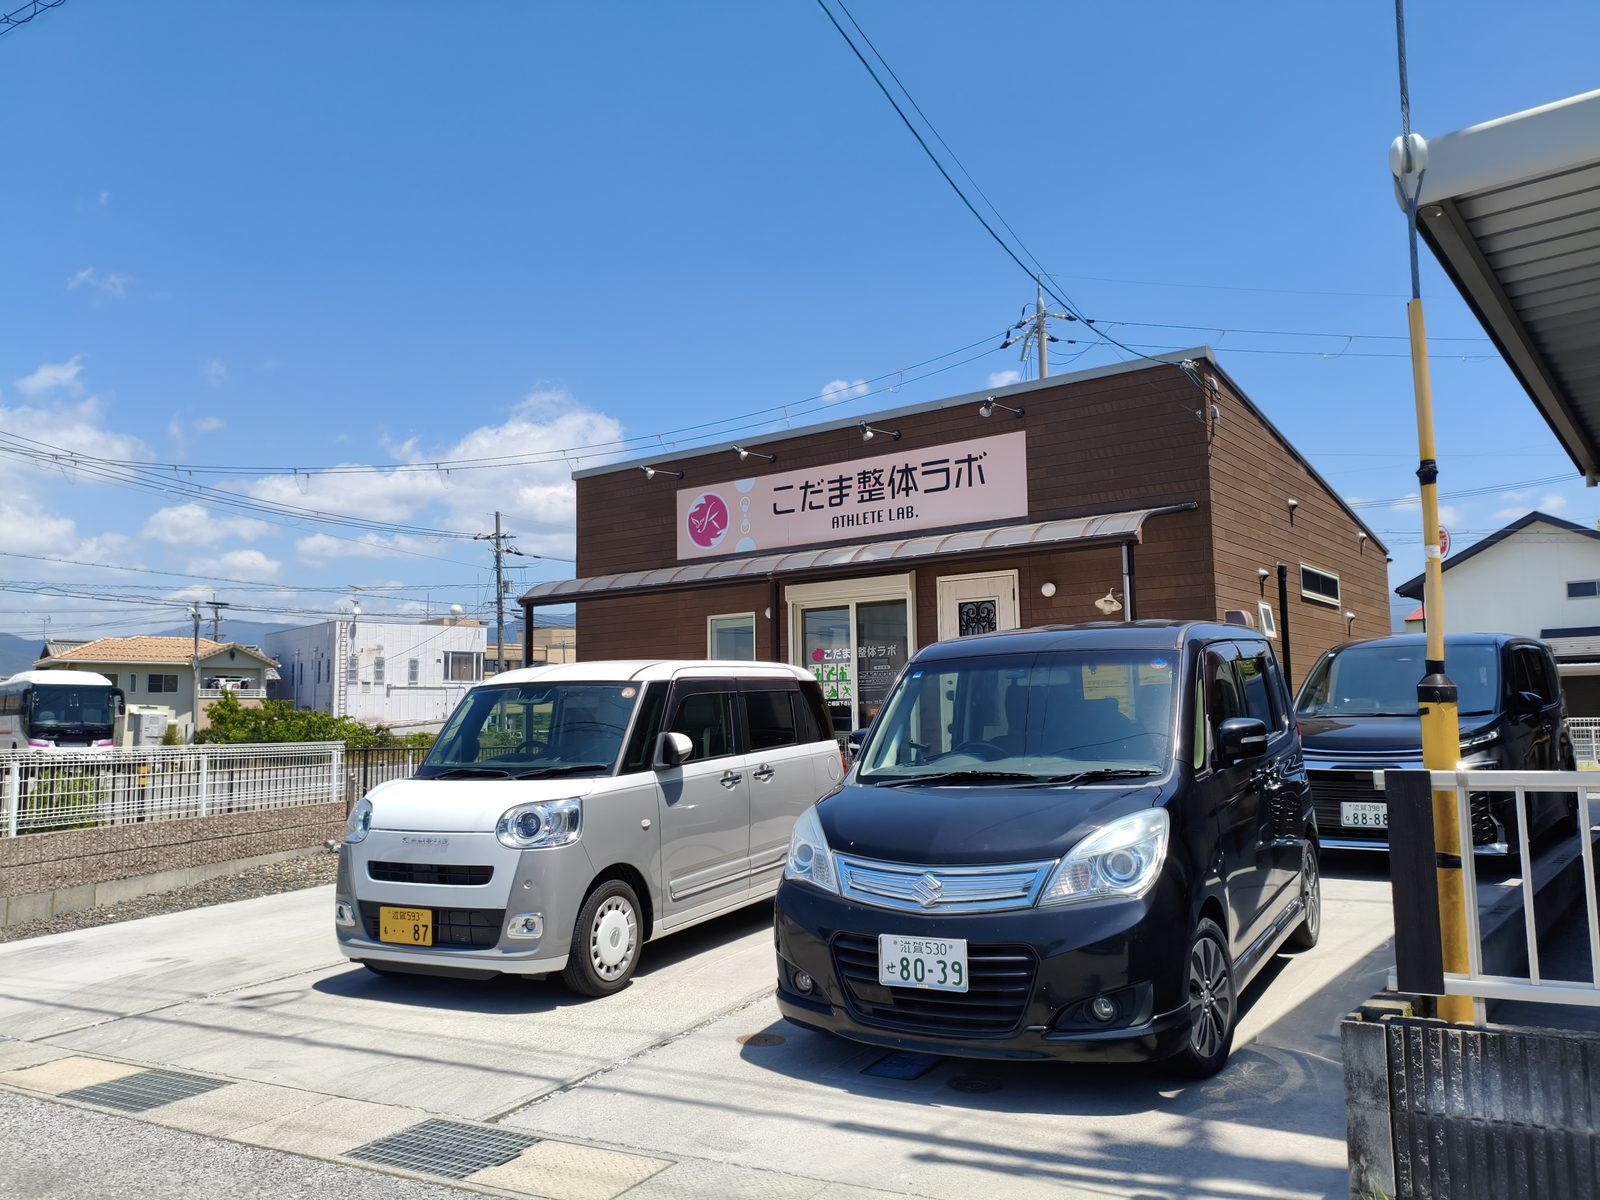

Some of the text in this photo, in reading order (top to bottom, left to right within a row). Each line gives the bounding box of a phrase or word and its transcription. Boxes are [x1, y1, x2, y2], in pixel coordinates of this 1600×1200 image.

[773, 451, 987, 515] こだま整体ラボ
[831, 505, 919, 529] ATHLETE LAB.
[823, 645, 897, 660] こだま 整体ラボ
[899, 956, 963, 986] 80-39
